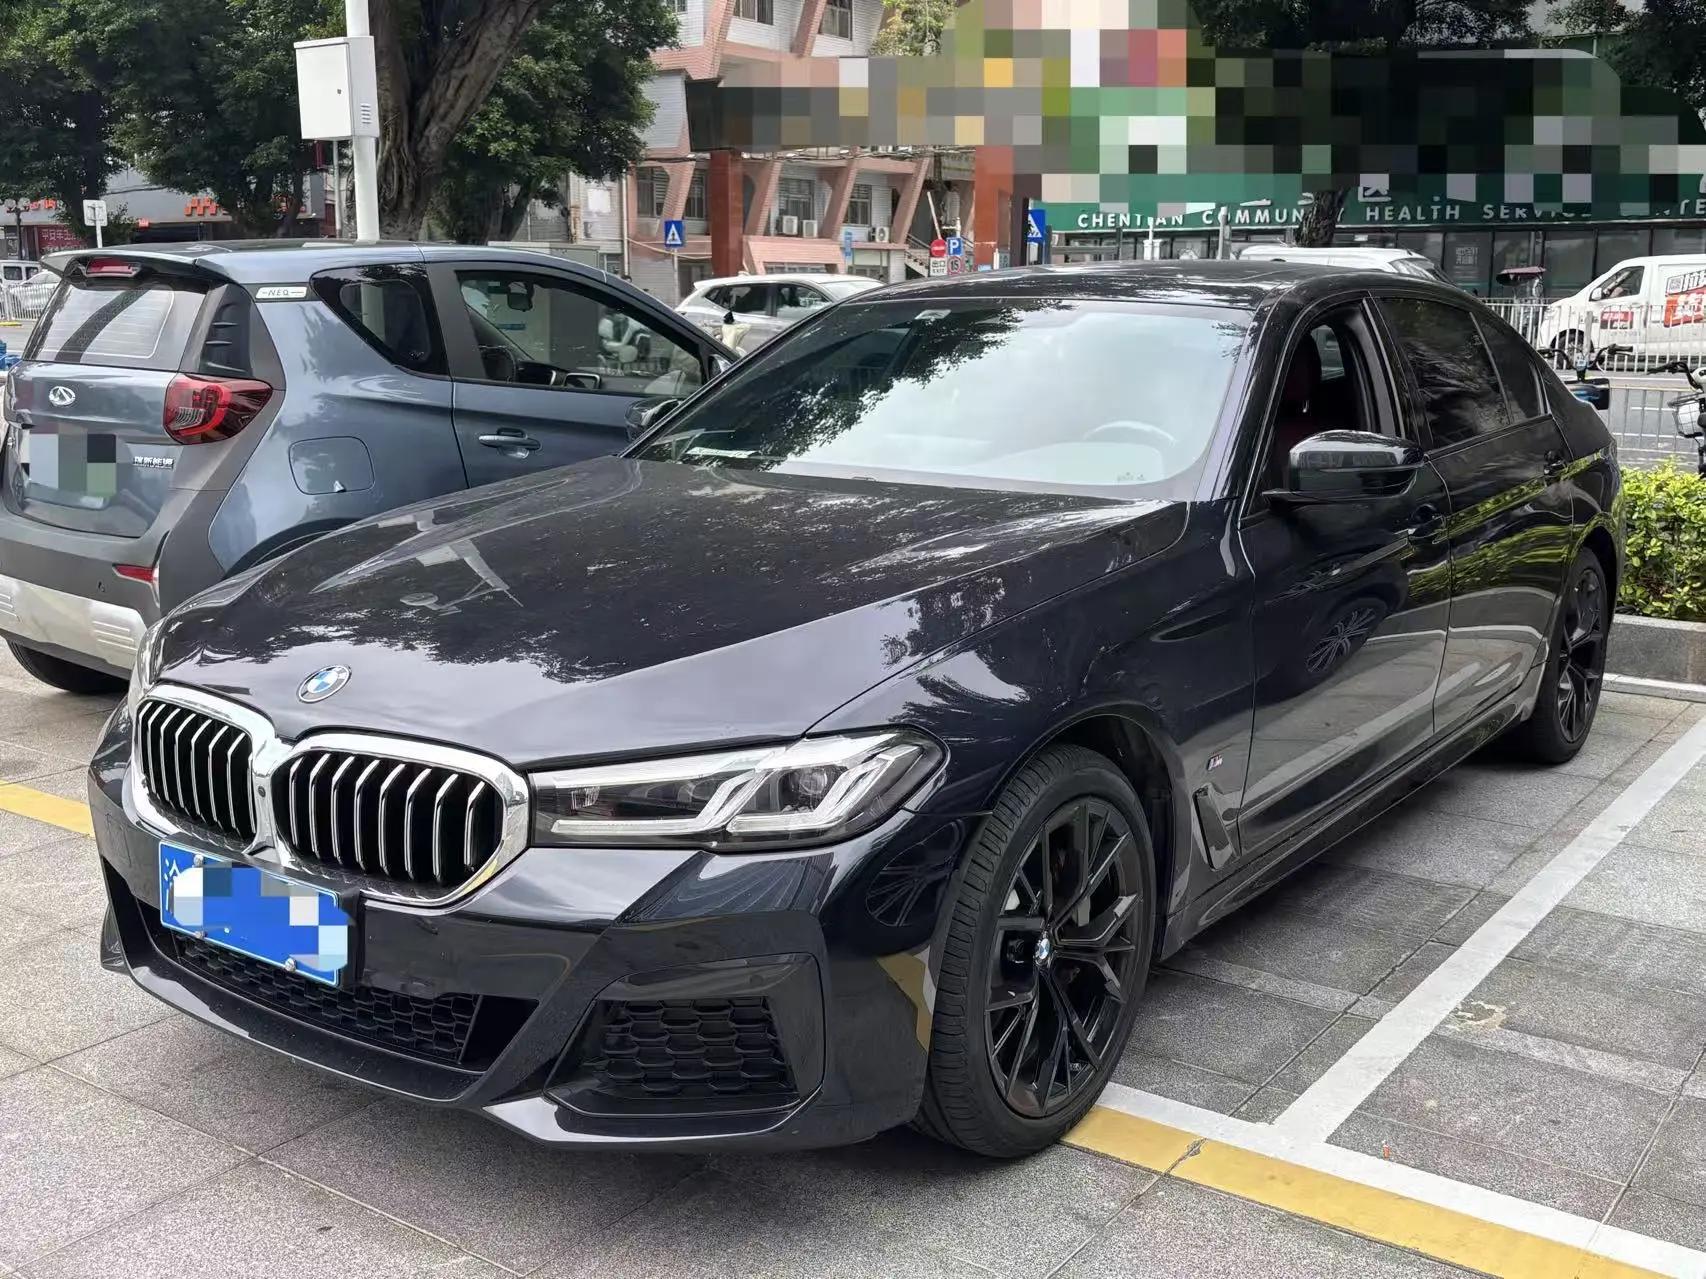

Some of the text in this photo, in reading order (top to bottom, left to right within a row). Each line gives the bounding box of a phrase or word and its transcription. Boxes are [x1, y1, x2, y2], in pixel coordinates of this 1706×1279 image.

[1366, 205, 1459, 221] HEALTH
[950, 239, 959, 254] P
[951, 260, 959, 271] 15
